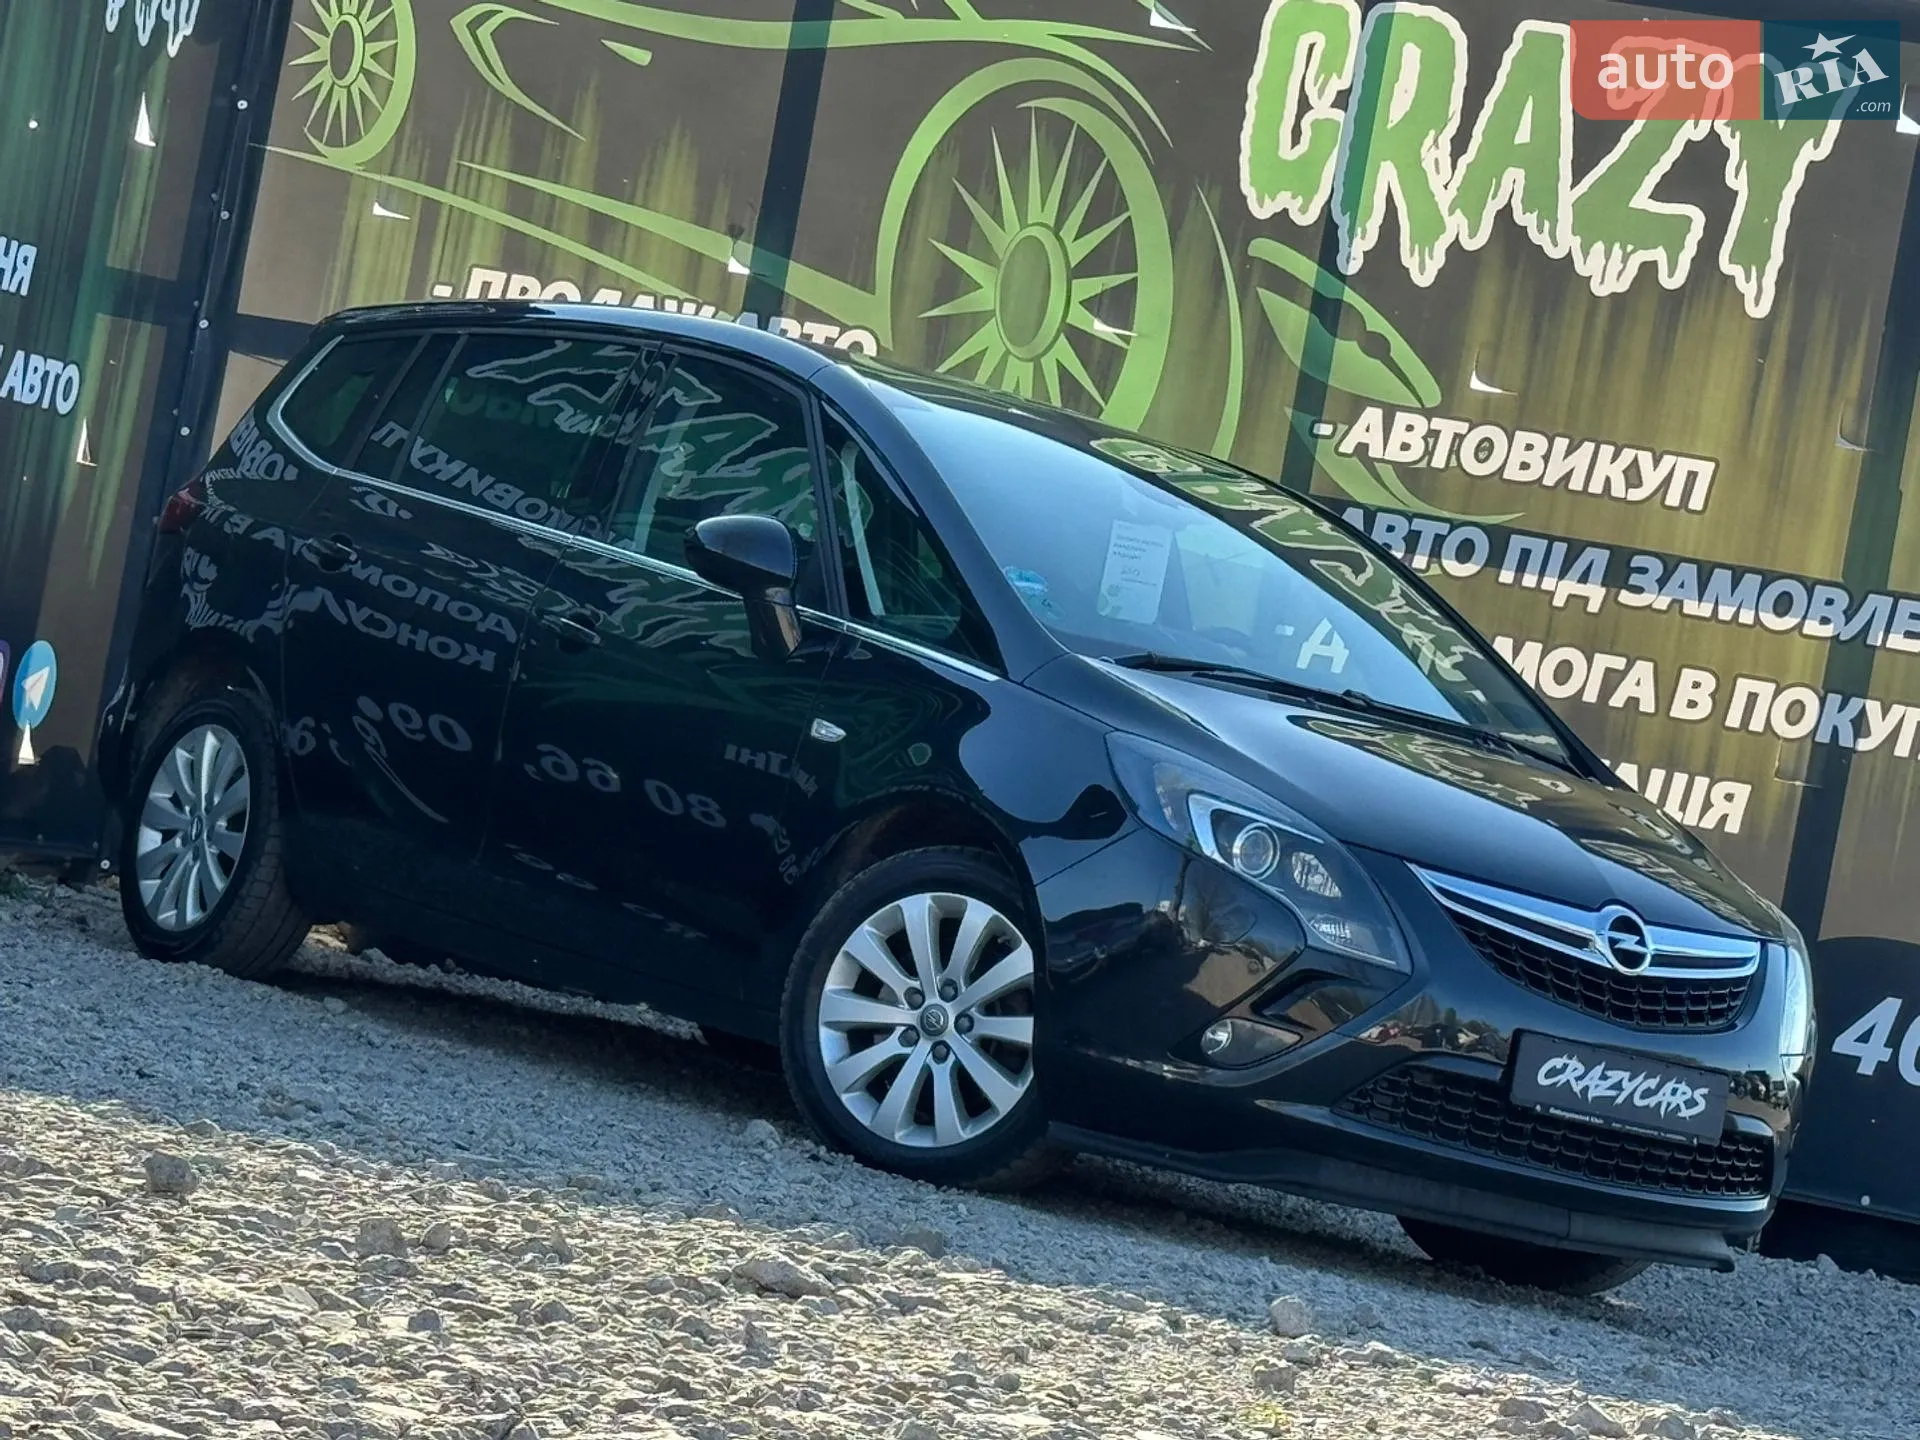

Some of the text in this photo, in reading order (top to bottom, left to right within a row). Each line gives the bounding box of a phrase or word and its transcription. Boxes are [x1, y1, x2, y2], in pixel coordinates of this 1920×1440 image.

[1240, 0, 1858, 319] CRAZY
[0, 350, 81, 416] АВТО
[1337, 406, 1717, 511] АВТОВИКУП
[1497, 534, 1612, 614] ПІД
[1670, 668, 1717, 721] В
